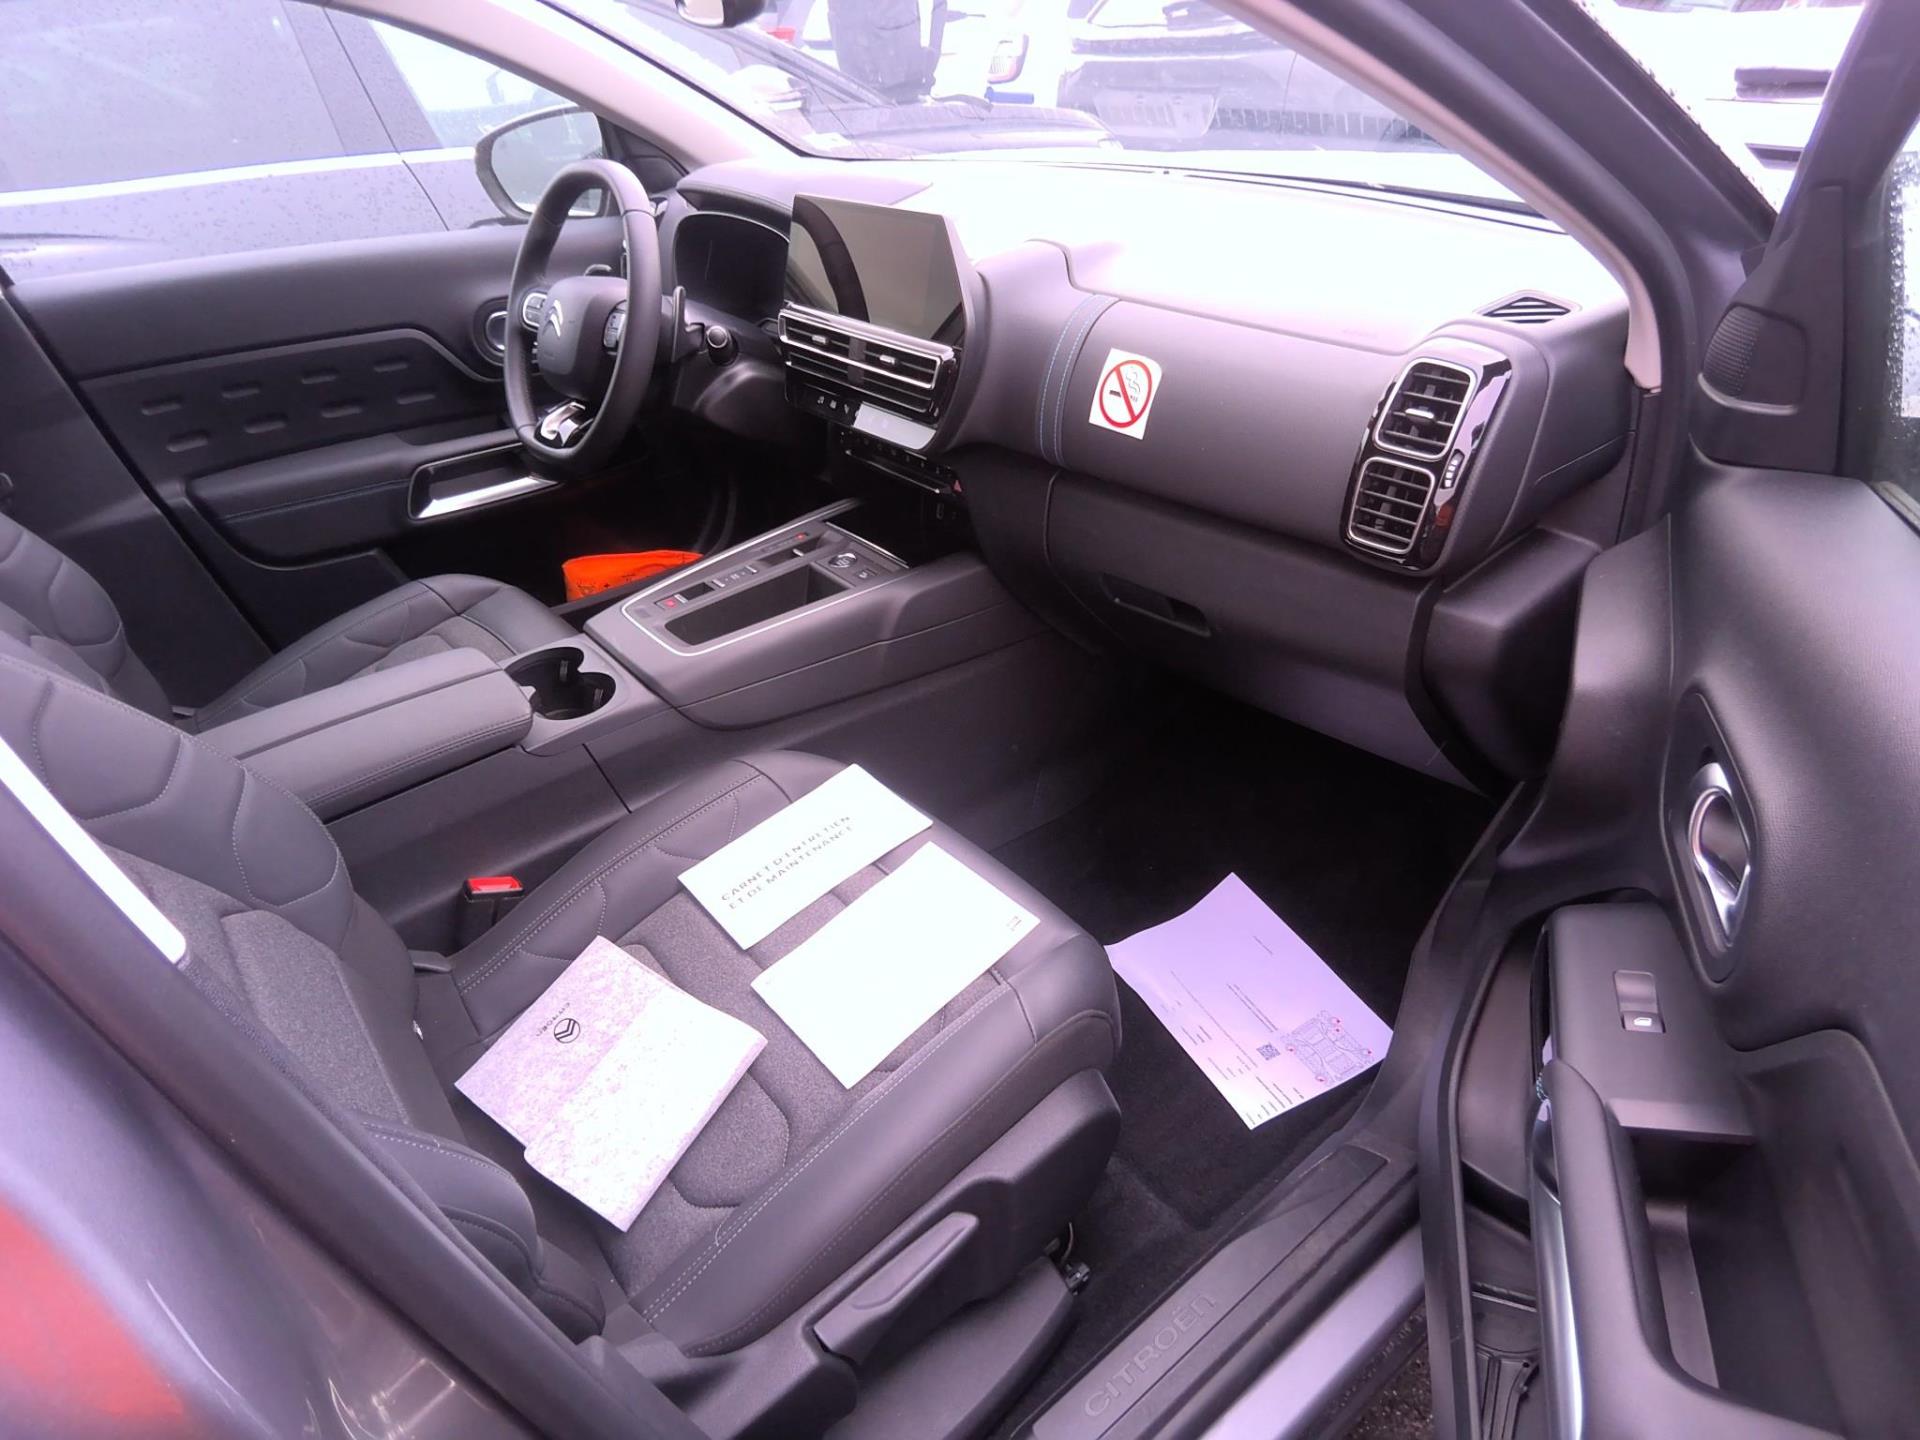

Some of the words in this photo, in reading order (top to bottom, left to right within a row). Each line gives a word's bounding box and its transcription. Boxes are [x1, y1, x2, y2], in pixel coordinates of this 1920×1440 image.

[721, 865, 771, 901] CARNET
[729, 896, 745, 910] ET
[747, 884, 764, 898] DE
[766, 826, 853, 884] MAINTENANCE
